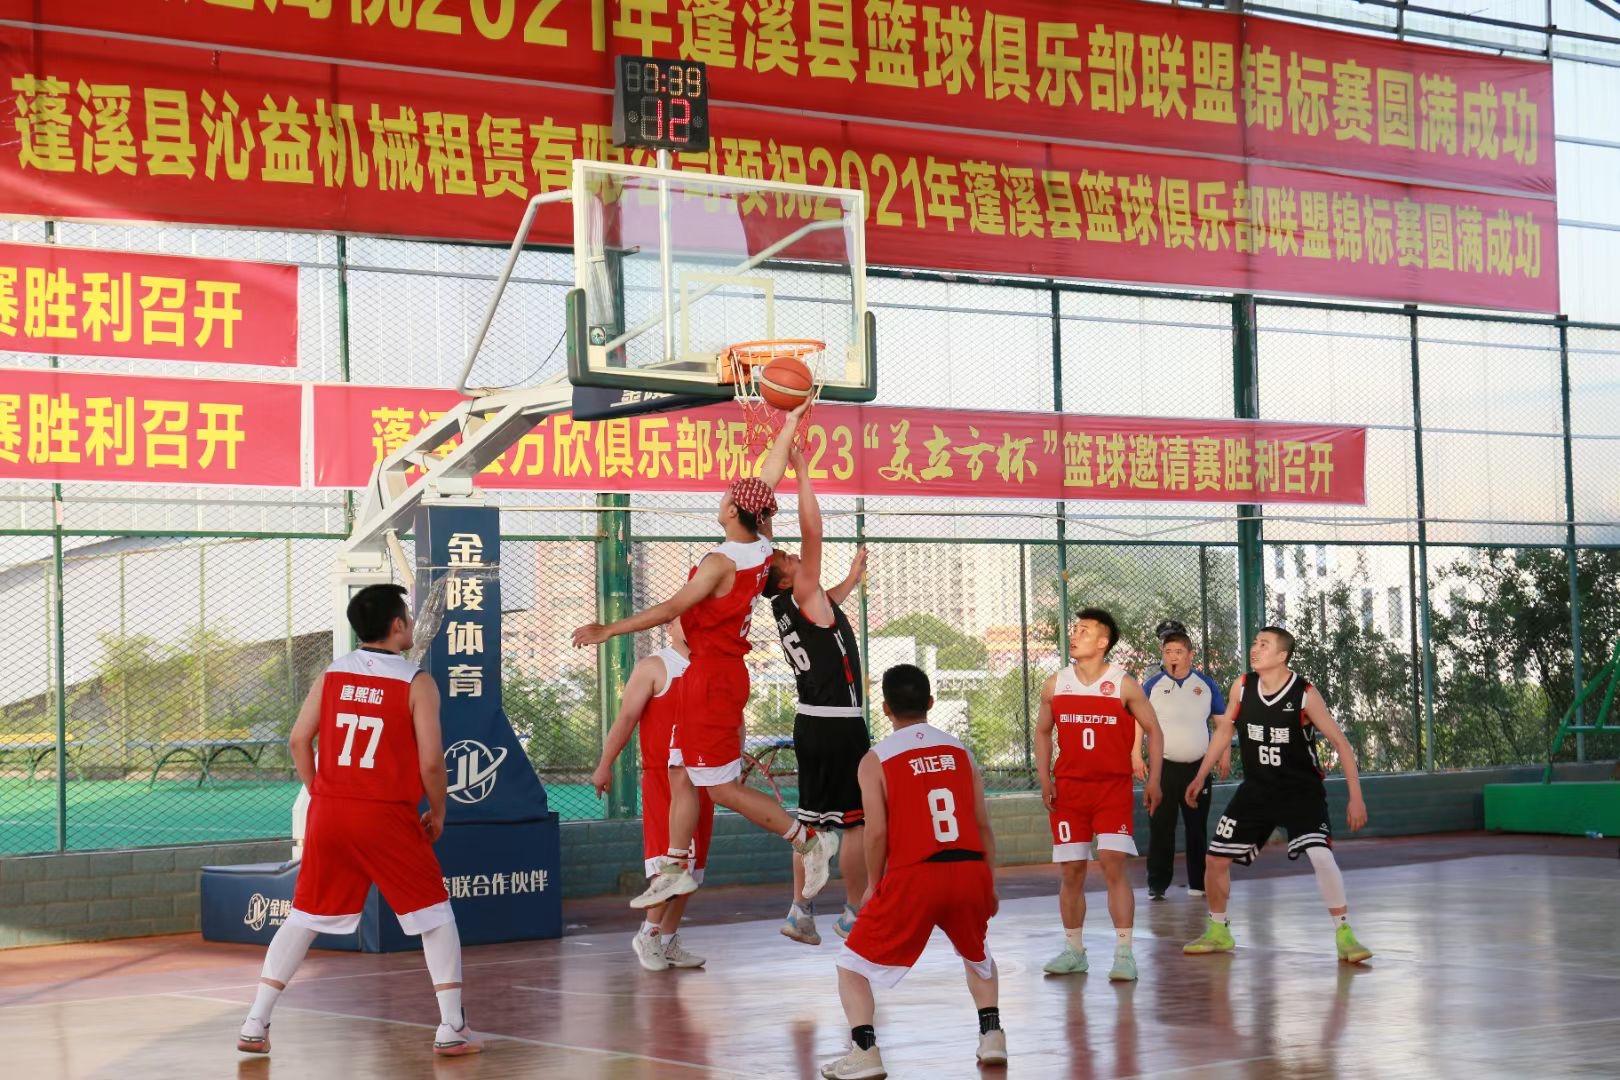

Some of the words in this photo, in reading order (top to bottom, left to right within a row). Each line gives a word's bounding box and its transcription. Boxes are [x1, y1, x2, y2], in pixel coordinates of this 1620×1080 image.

[656, 98, 691, 143] 12
[446, 533, 484, 697] 金陵体育
[335, 712, 384, 769] 77
[1082, 727, 1095, 750] 0
[1258, 745, 1281, 767] 66
[927, 787, 959, 843] 8
[1058, 820, 1071, 843] 0
[1215, 815, 1238, 839] 66
